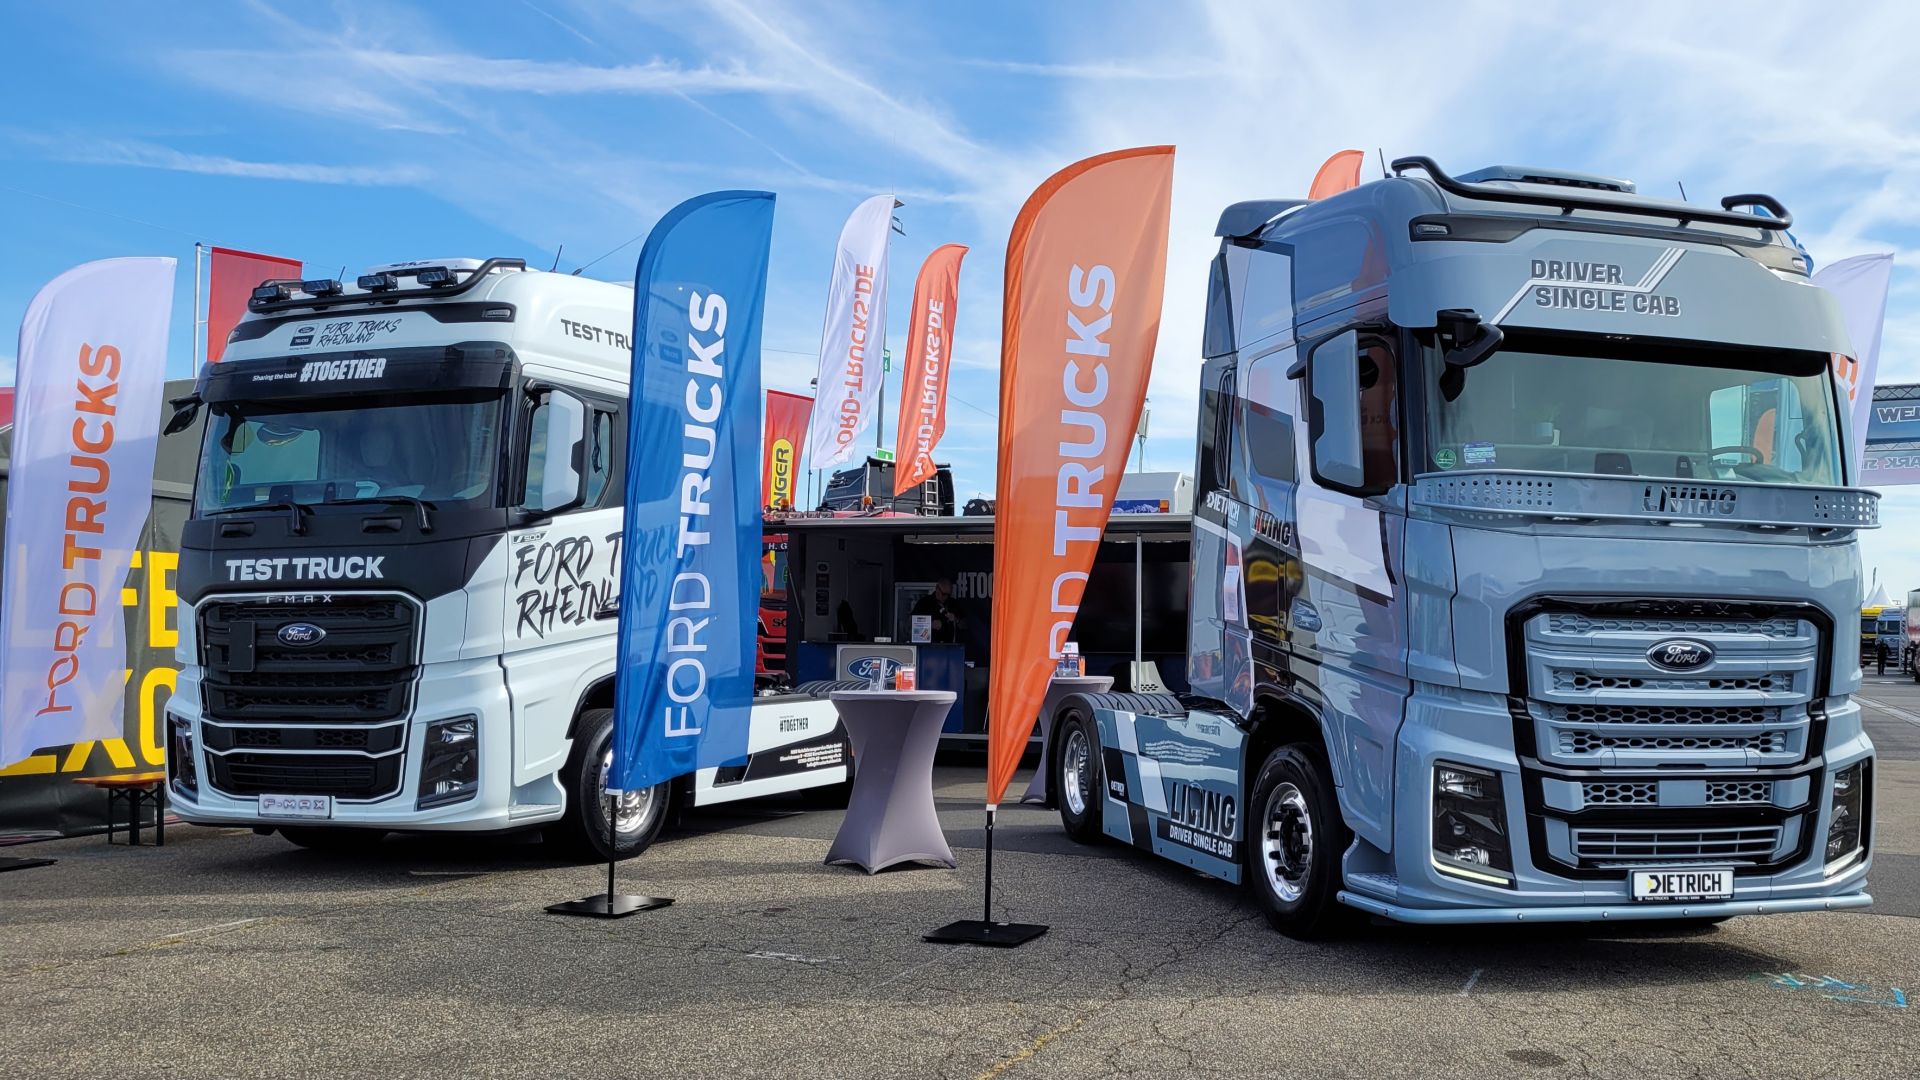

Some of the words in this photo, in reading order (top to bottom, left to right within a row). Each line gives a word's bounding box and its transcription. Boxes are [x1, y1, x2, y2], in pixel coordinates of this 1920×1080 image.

[1531, 259, 1623, 285] DRIVER
[1535, 287, 1627, 313] SINGLE
[1633, 293, 1681, 317] CAB
[322, 321, 353, 335] FORD
[355, 318, 403, 333] TRUCKS
[560, 318, 602, 343] TEST
[316, 332, 376, 347] RHEINLAND
[252, 374, 274, 382] Sharing
[300, 358, 387, 382] #TOGETHER
[1053, 263, 1116, 556] TRUCKS
[677, 290, 728, 559] TRUCKS
[63, 342, 122, 570] TRUCKS
[1642, 485, 1737, 515] LIVING
[225, 558, 289, 582] TEST
[292, 556, 385, 580] TRUCK
[514, 535, 594, 589] FORD
[266, 594, 333, 604] F-MAX
[286, 626, 313, 641] Ford
[664, 572, 711, 738] FORD
[1663, 645, 1702, 664] Ford
[779, 717, 809, 733] #TOGETHER
[263, 798, 325, 810] F-MAX
[1169, 824, 1192, 844] DRIVER
[1193, 832, 1217, 853] SINGLE
[1217, 840, 1233, 859] CAB
[1648, 873, 1722, 894] DIETRICH
